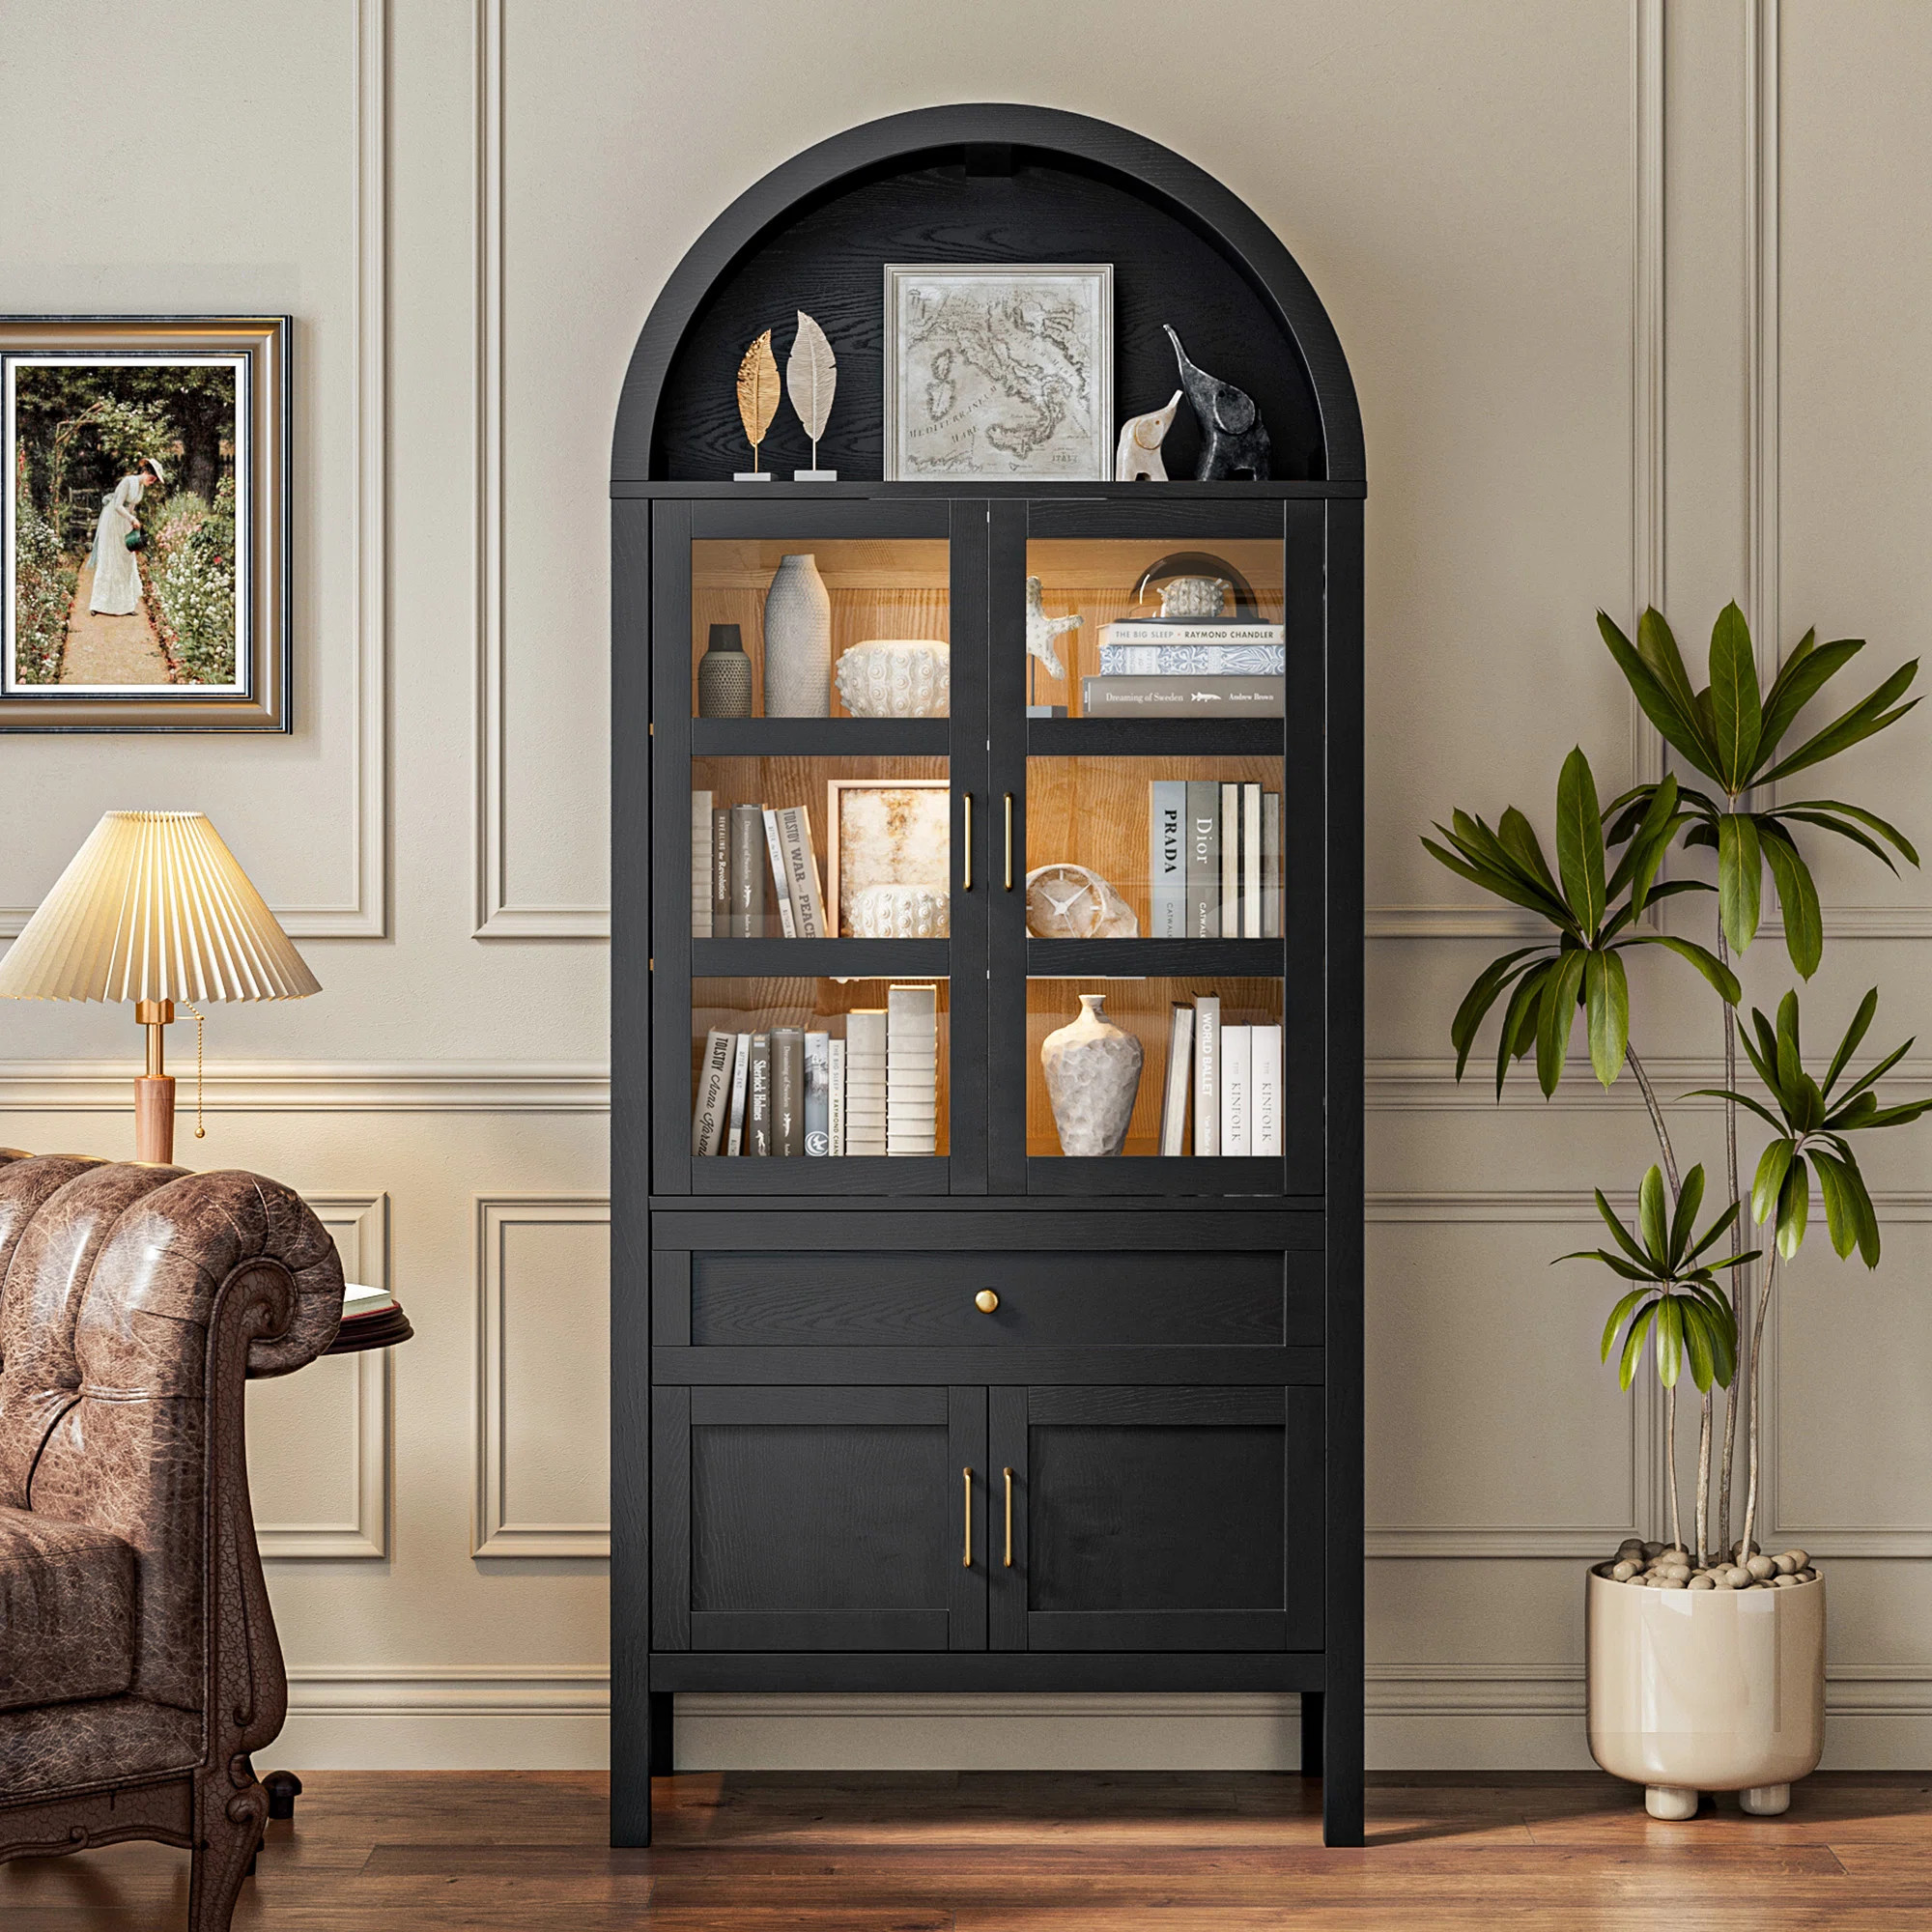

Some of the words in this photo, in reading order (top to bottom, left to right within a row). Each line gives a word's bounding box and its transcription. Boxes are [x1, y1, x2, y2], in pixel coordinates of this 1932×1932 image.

[1105, 692, 1144, 703] Dreaming
[1144, 692, 1153, 701] of
[1153, 692, 1183, 701] Sweden
[1229, 693, 1252, 701] Andrew
[1254, 693, 1274, 701] Brown
[743, 820, 752, 849] Dreaming
[783, 810, 801, 843] TOLSTOY
[1164, 810, 1178, 873] PRADA
[1196, 817, 1213, 865] Dior
[718, 861, 726, 899] Revolution
[790, 847, 806, 883] WAR
[799, 895, 816, 939] PEACE
[1202, 1012, 1212, 1054] WORLD
[711, 1037, 729, 1072] TOLSTOY
[781, 1045, 791, 1075] Dreaming
[706, 1074, 721, 1109] Anna
[753, 1060, 766, 1092] Sherlock
[1202, 1057, 1212, 1096] BALLET
[753, 1094, 766, 1122] Holmes
[1231, 1082, 1241, 1142] KINFOLK
[1262, 1082, 1272, 1142] KINFOLK
